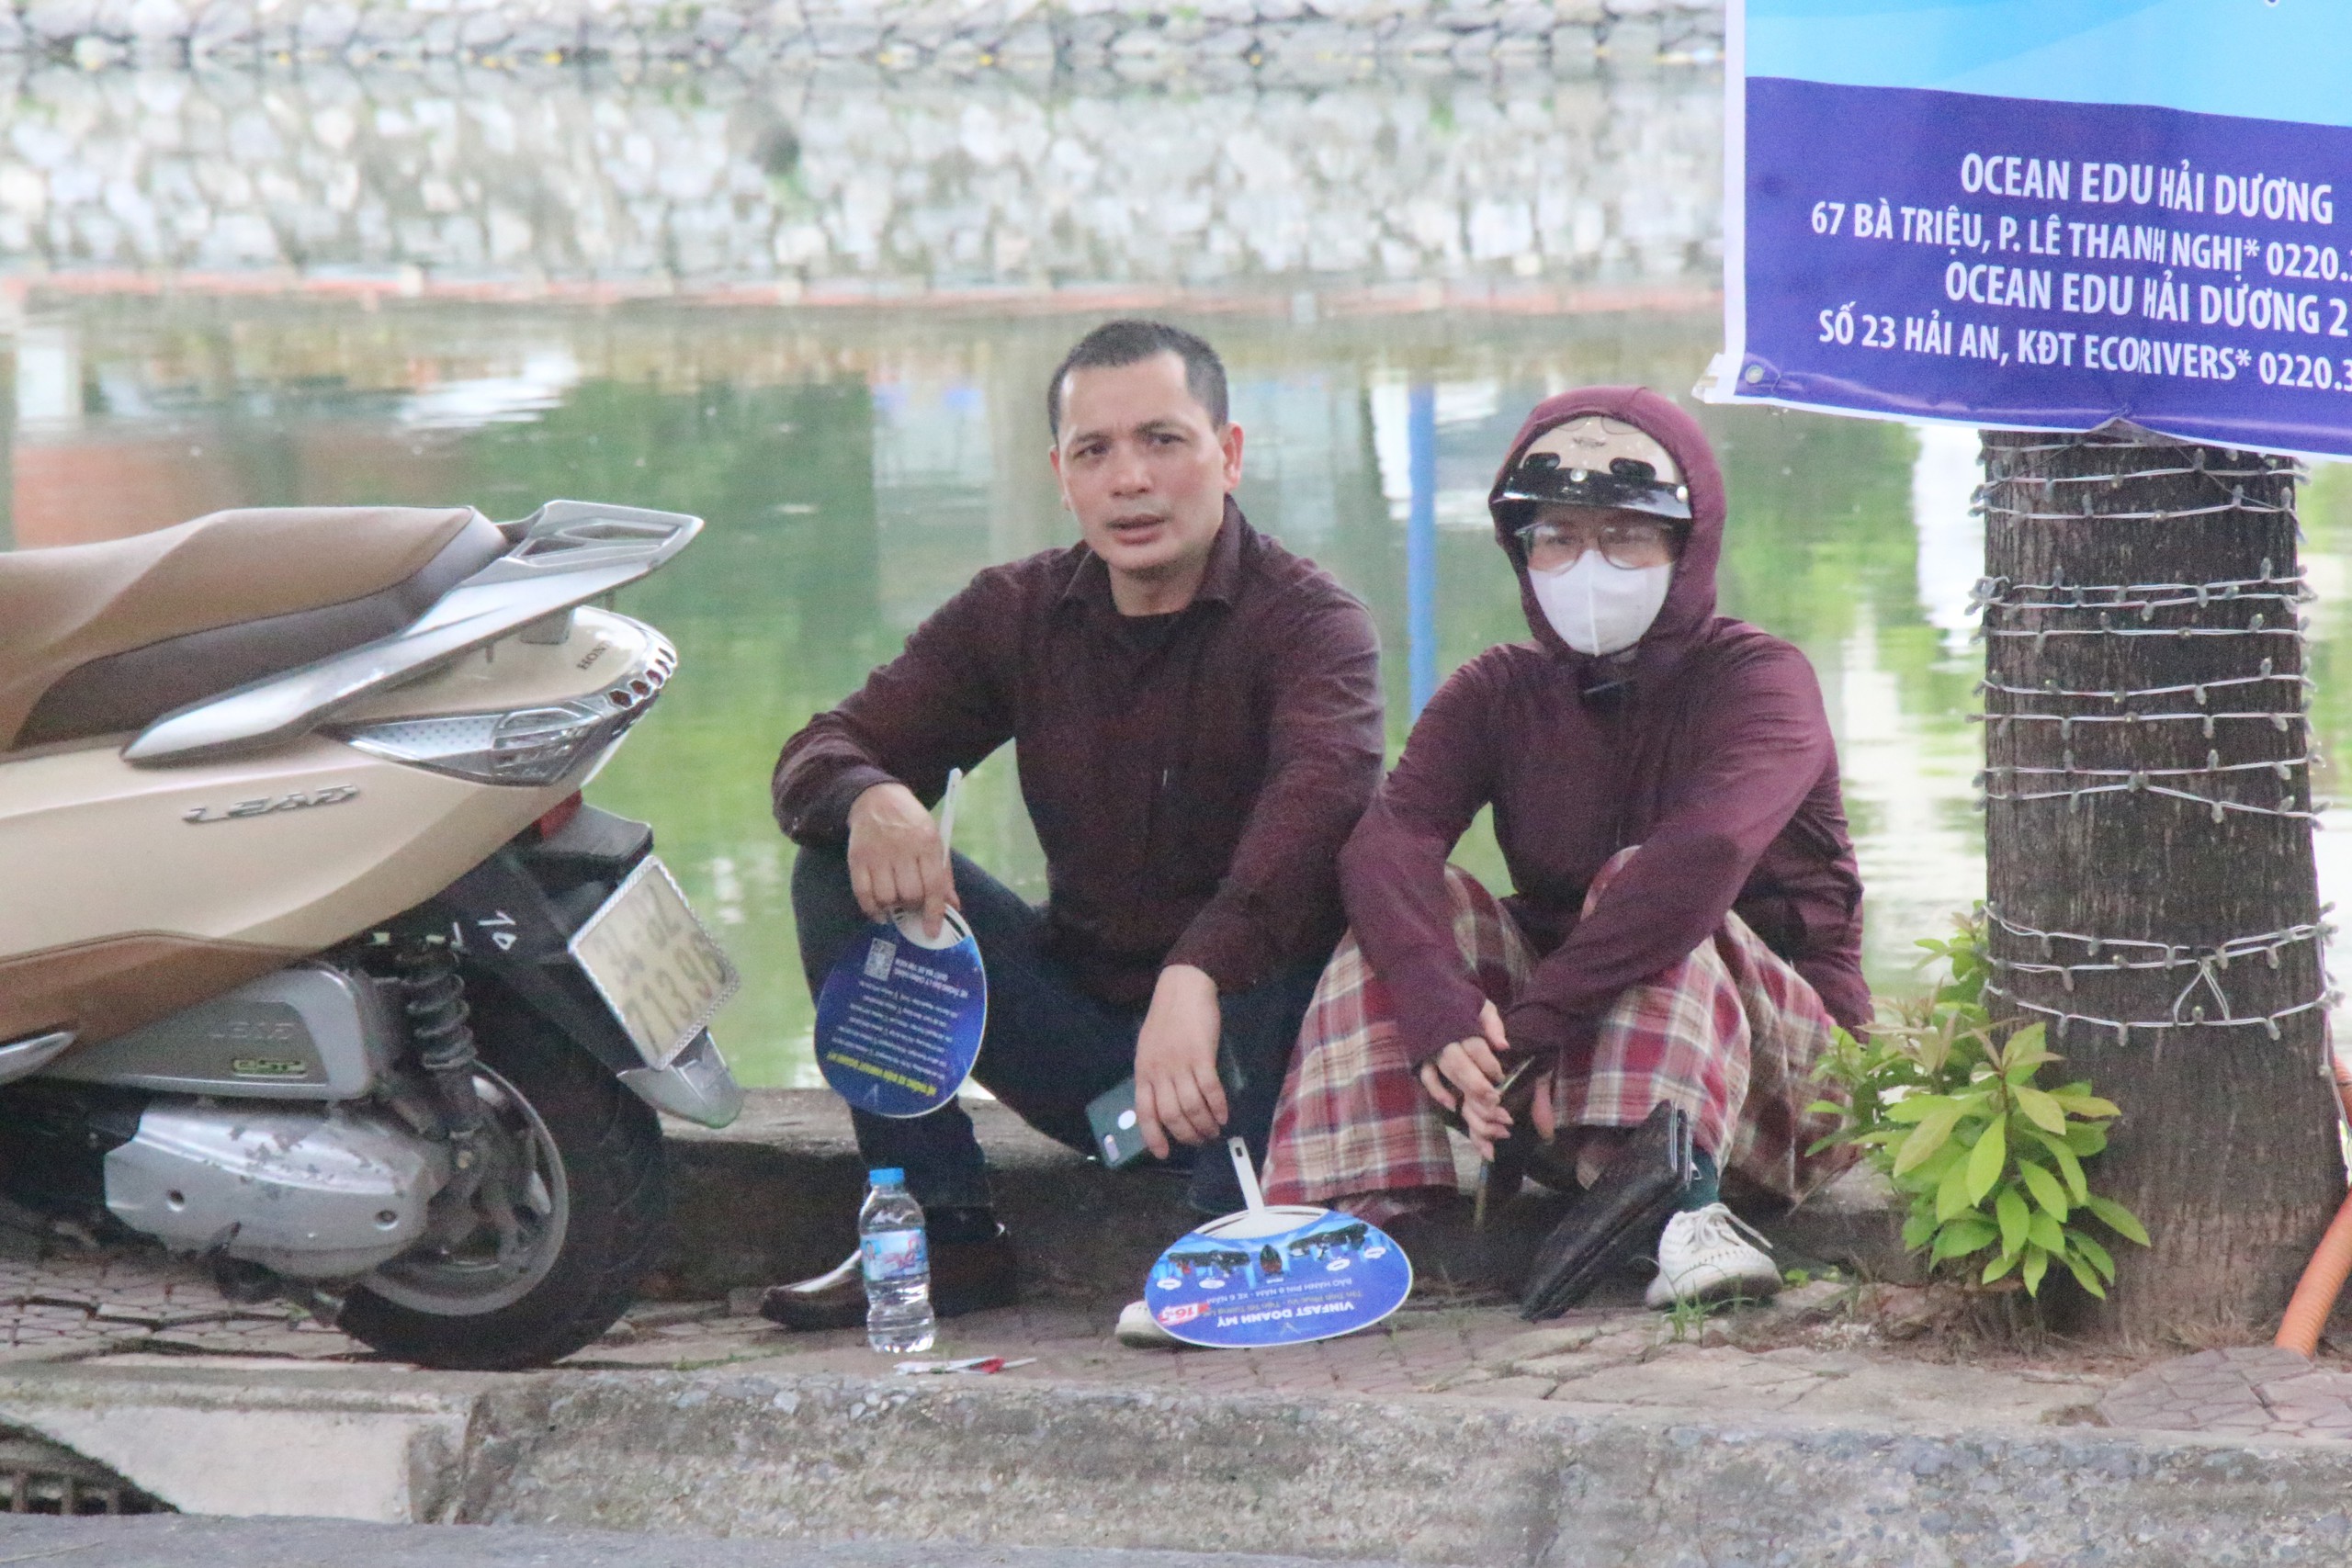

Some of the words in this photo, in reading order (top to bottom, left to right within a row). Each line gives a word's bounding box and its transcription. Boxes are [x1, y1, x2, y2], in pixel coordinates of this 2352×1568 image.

[1961, 152, 2071, 200] OCEAN
[2081, 162, 2154, 205] EDU
[2158, 159, 2205, 213] HẢI
[2214, 173, 2333, 224] DƯƠNG
[1811, 201, 1846, 235] 67
[1854, 197, 1894, 240] BÀ
[1900, 205, 1991, 255] TRIỆU,
[1998, 216, 2021, 252] P.
[2029, 214, 2061, 255] LÊ
[2068, 222, 2166, 265] THANH
[2266, 242, 2352, 281] 0220.
[1945, 261, 2052, 310] OCEAN
[2062, 272, 2133, 316] EDU
[2143, 269, 2189, 322] HẢI
[2199, 283, 2320, 334] DƯƠNG
[2328, 298, 2348, 337] 2
[1818, 300, 1857, 345] SỐ
[1861, 314, 1896, 349] 23
[1904, 309, 1952, 355] HẢI
[1959, 322, 2009, 367] AN,
[2018, 329, 2076, 367] KĐT
[183, 783, 361, 824] LEAD
[1240, 1308, 1293, 1324] DOANH
[1295, 1301, 1355, 1317] VINFAST
